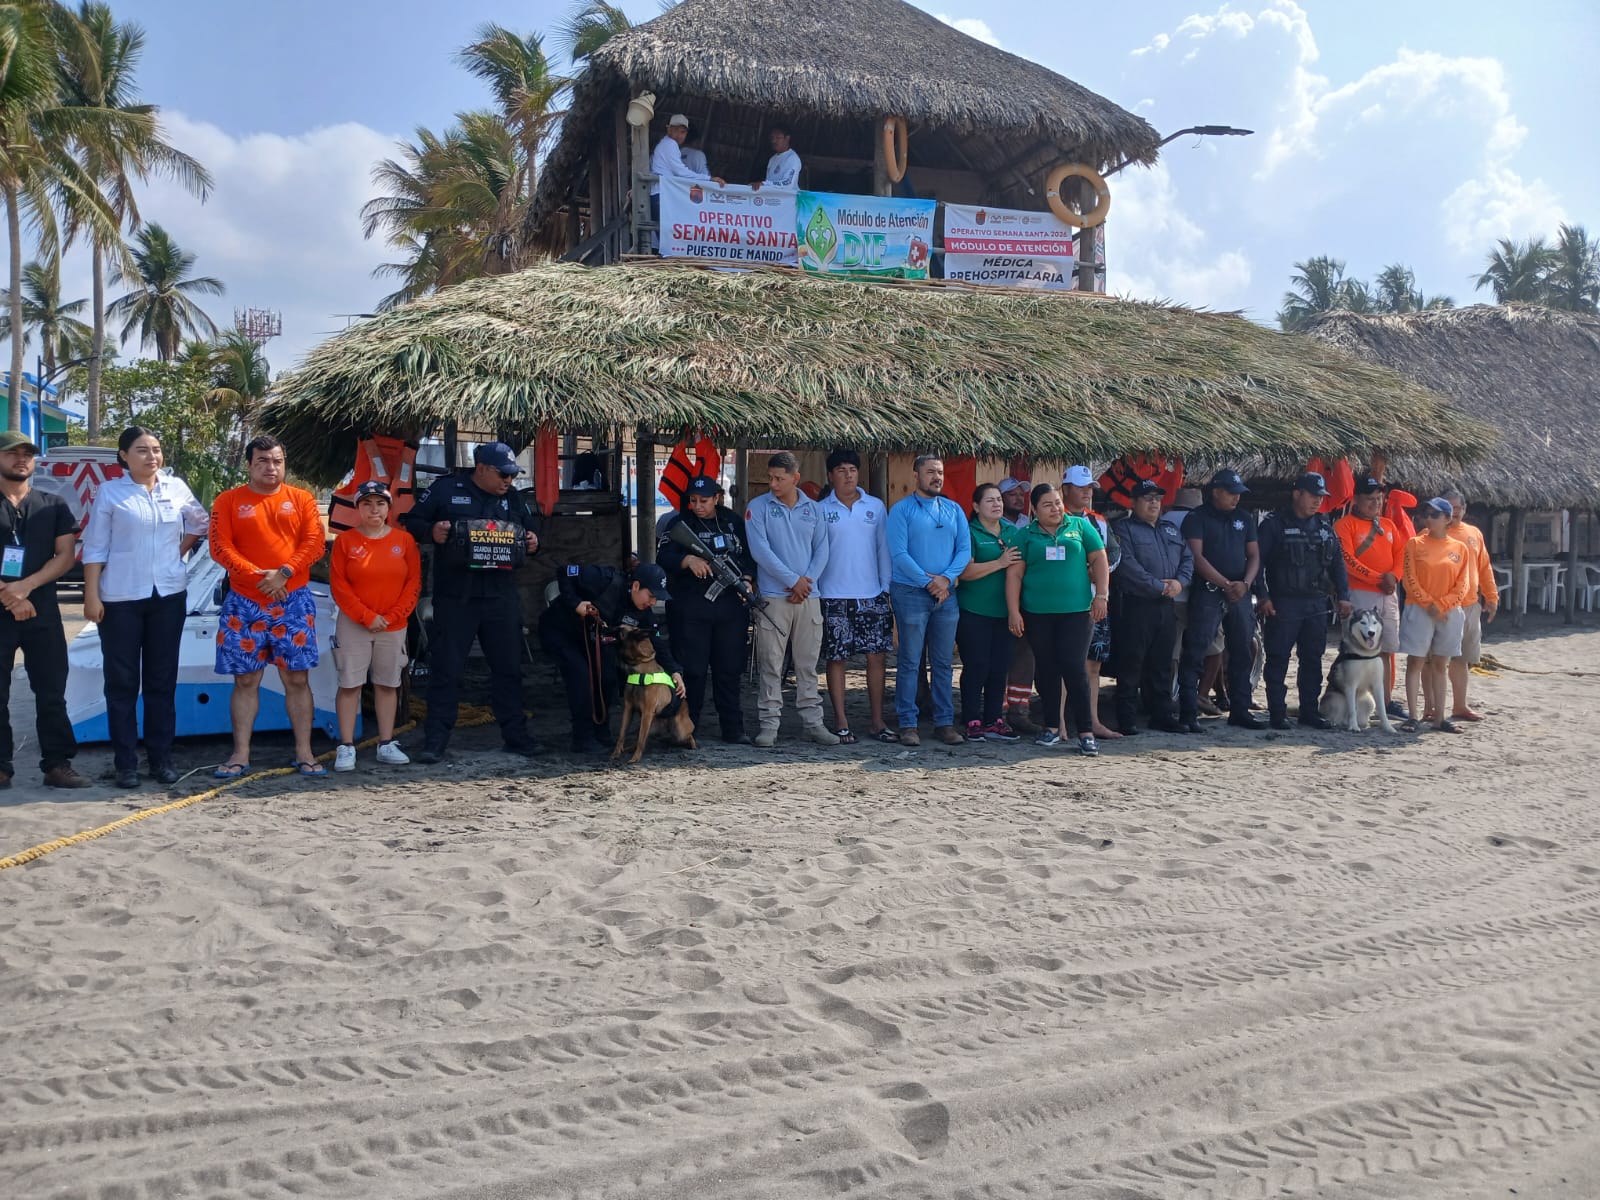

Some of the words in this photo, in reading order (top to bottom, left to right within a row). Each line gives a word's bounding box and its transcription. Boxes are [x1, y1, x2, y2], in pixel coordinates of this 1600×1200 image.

[699, 211, 772, 228] OPERATIVO
[837, 208, 872, 227] Módulo
[875, 212, 886, 228] de
[888, 213, 929, 230] Atención
[672, 223, 740, 244] SEMANA
[746, 230, 798, 248] SANTA
[951, 227, 992, 236] OPERATIVO
[993, 229, 1023, 237] SEMANA
[1025, 230, 1049, 238] SANTA
[686, 244, 727, 258] PUESTO
[730, 248, 744, 259] DE
[746, 250, 783, 261] MANDO
[842, 230, 888, 268] DIF
[951, 240, 996, 251] MÓDULO
[998, 243, 1013, 252] DE
[1015, 242, 1067, 253] ATENCIÓN
[983, 256, 1033, 267] MÉDICA
[950, 270, 1064, 284] PREHOSPITALARIA
[470, 530, 515, 538] BOTIQUIN
[493, 546, 511, 554] ESTATAL
